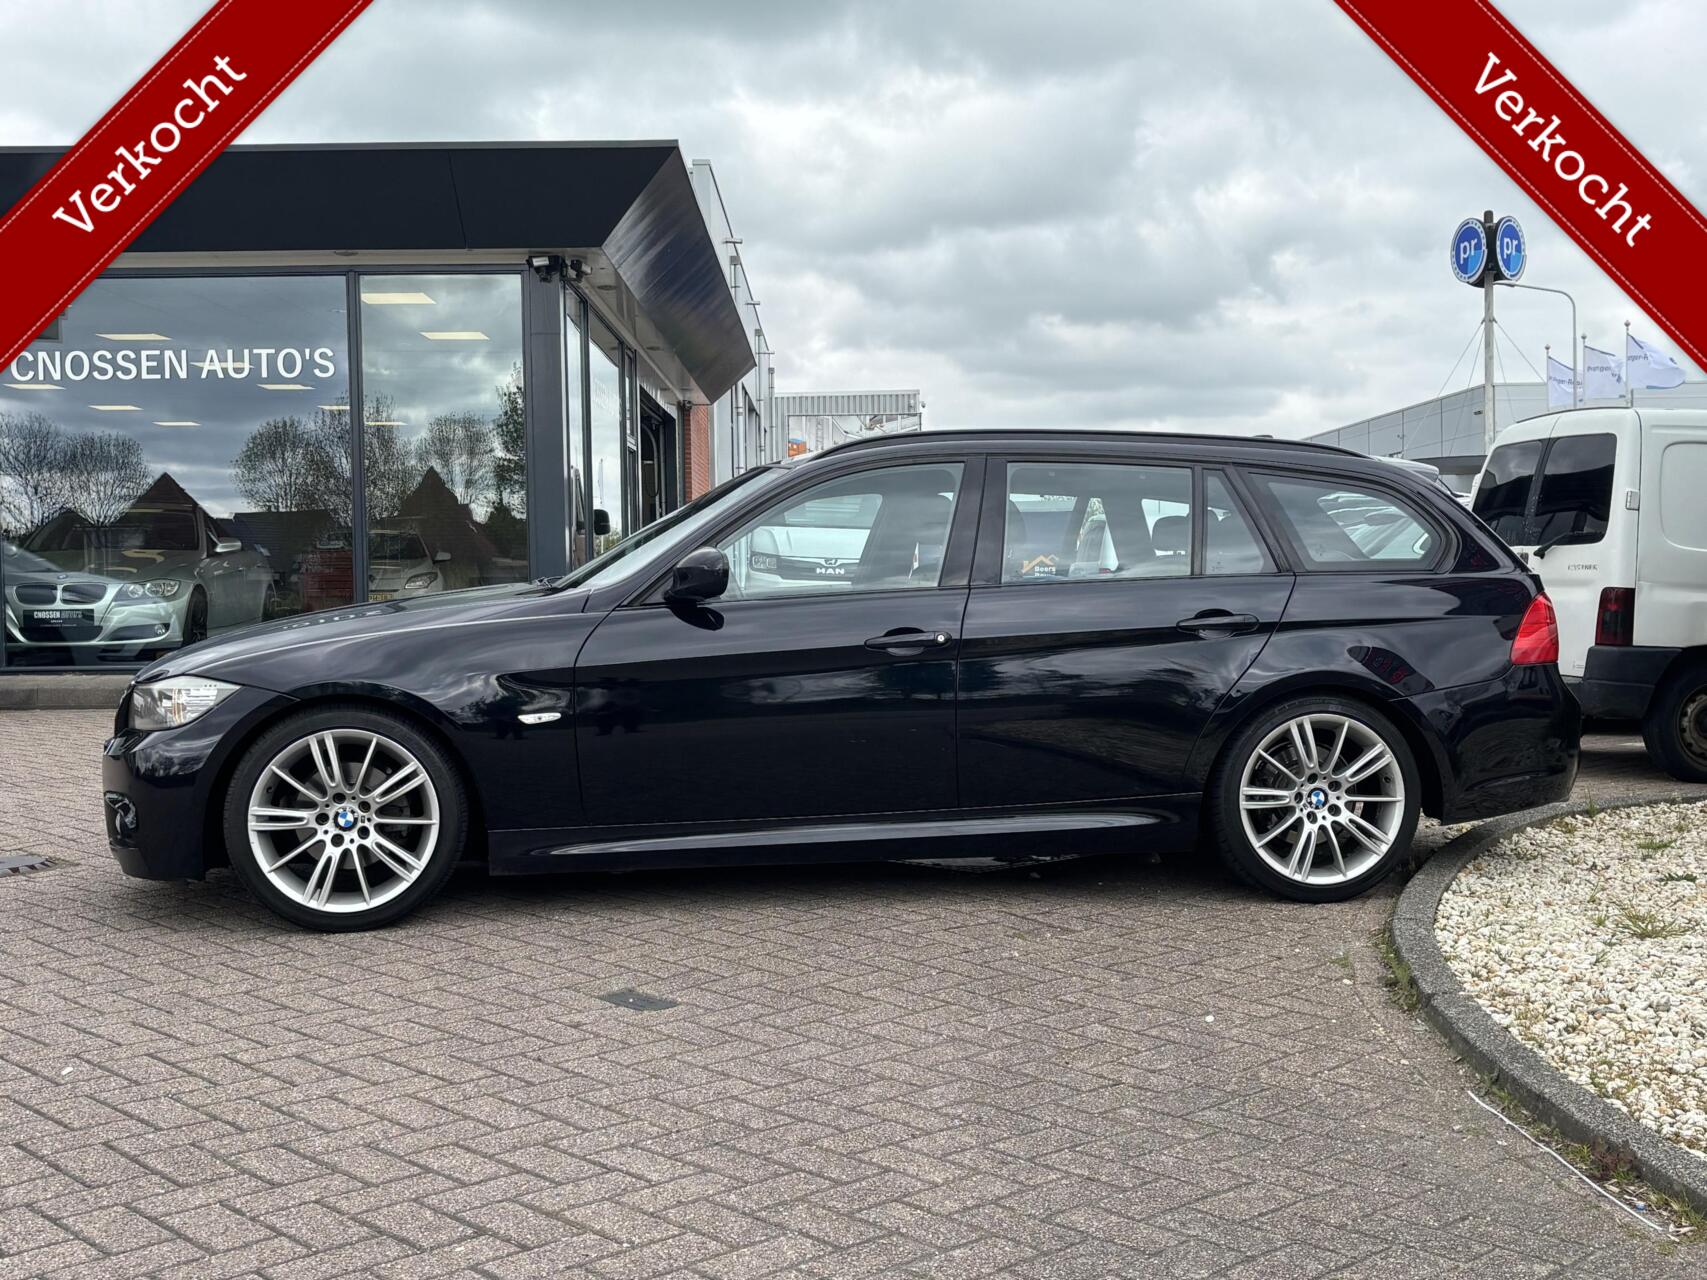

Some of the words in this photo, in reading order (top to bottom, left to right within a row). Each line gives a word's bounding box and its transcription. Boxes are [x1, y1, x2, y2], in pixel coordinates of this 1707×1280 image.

[1460, 238, 1478, 265] pr
[1503, 237, 1518, 259] pr
[9, 349, 188, 382] CNOSSEN
[200, 347, 336, 380] AUTO'S
[815, 567, 845, 575] MAN
